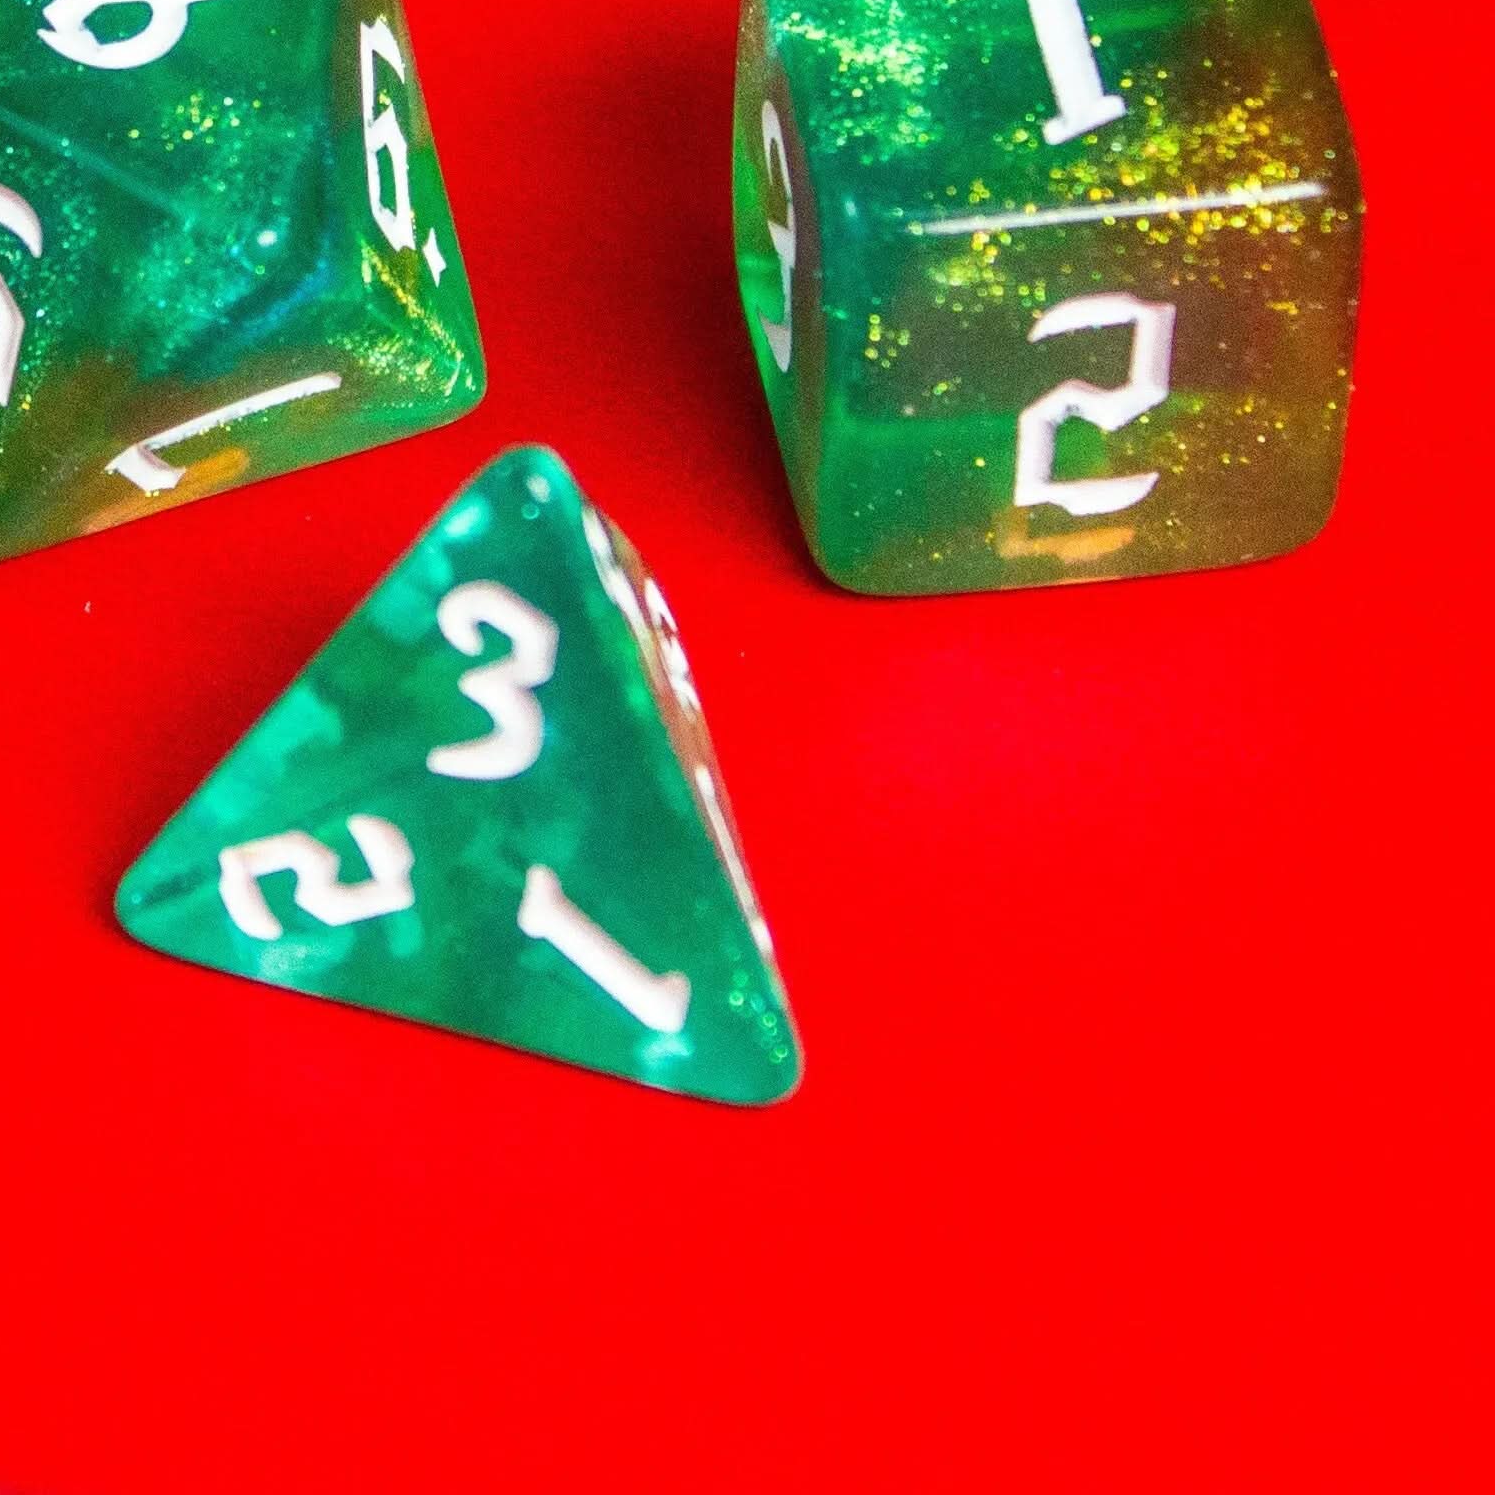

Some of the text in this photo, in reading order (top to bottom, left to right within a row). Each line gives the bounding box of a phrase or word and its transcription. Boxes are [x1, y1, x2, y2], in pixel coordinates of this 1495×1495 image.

[1012, 291, 1177, 518] 2
[426, 580, 558, 781] 3
[217, 814, 415, 942] 2
[516, 864, 691, 1037] 1
